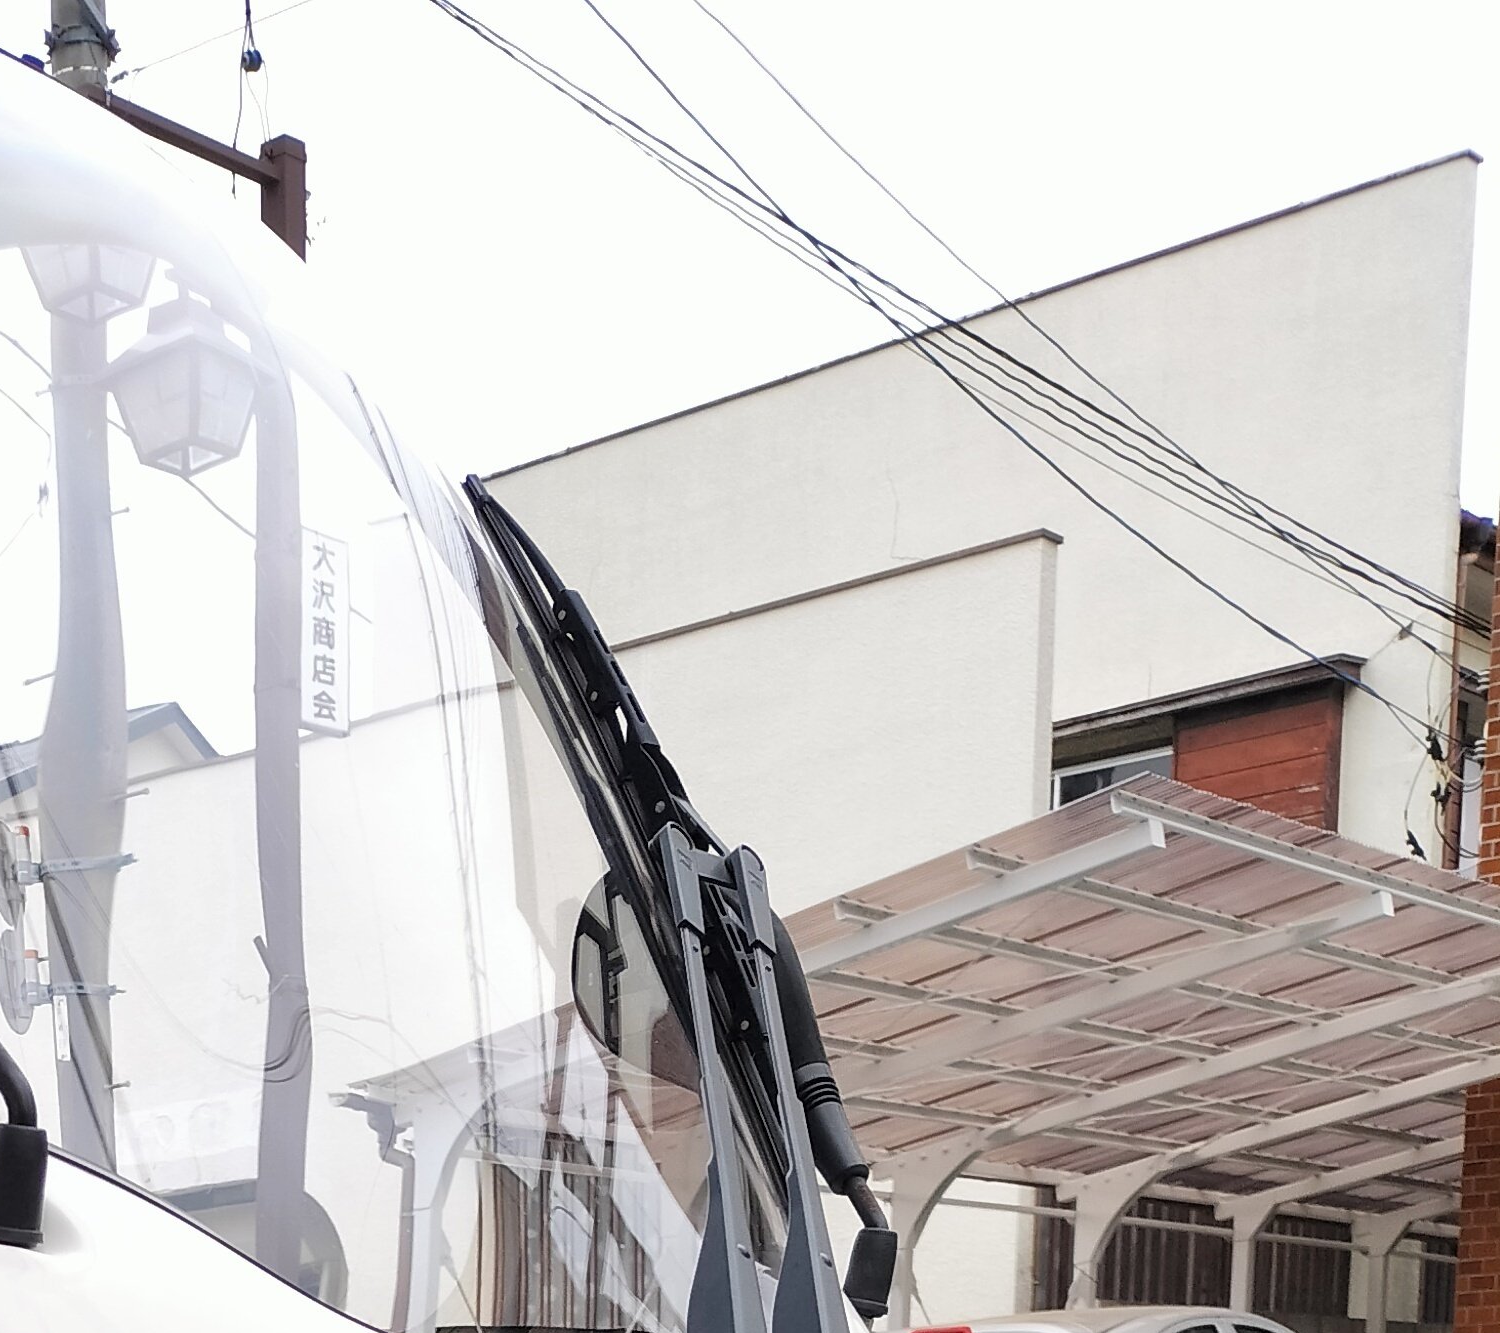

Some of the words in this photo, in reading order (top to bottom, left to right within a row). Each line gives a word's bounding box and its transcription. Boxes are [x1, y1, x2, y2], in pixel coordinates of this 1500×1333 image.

[312, 541, 337, 723] 大沢商店会
